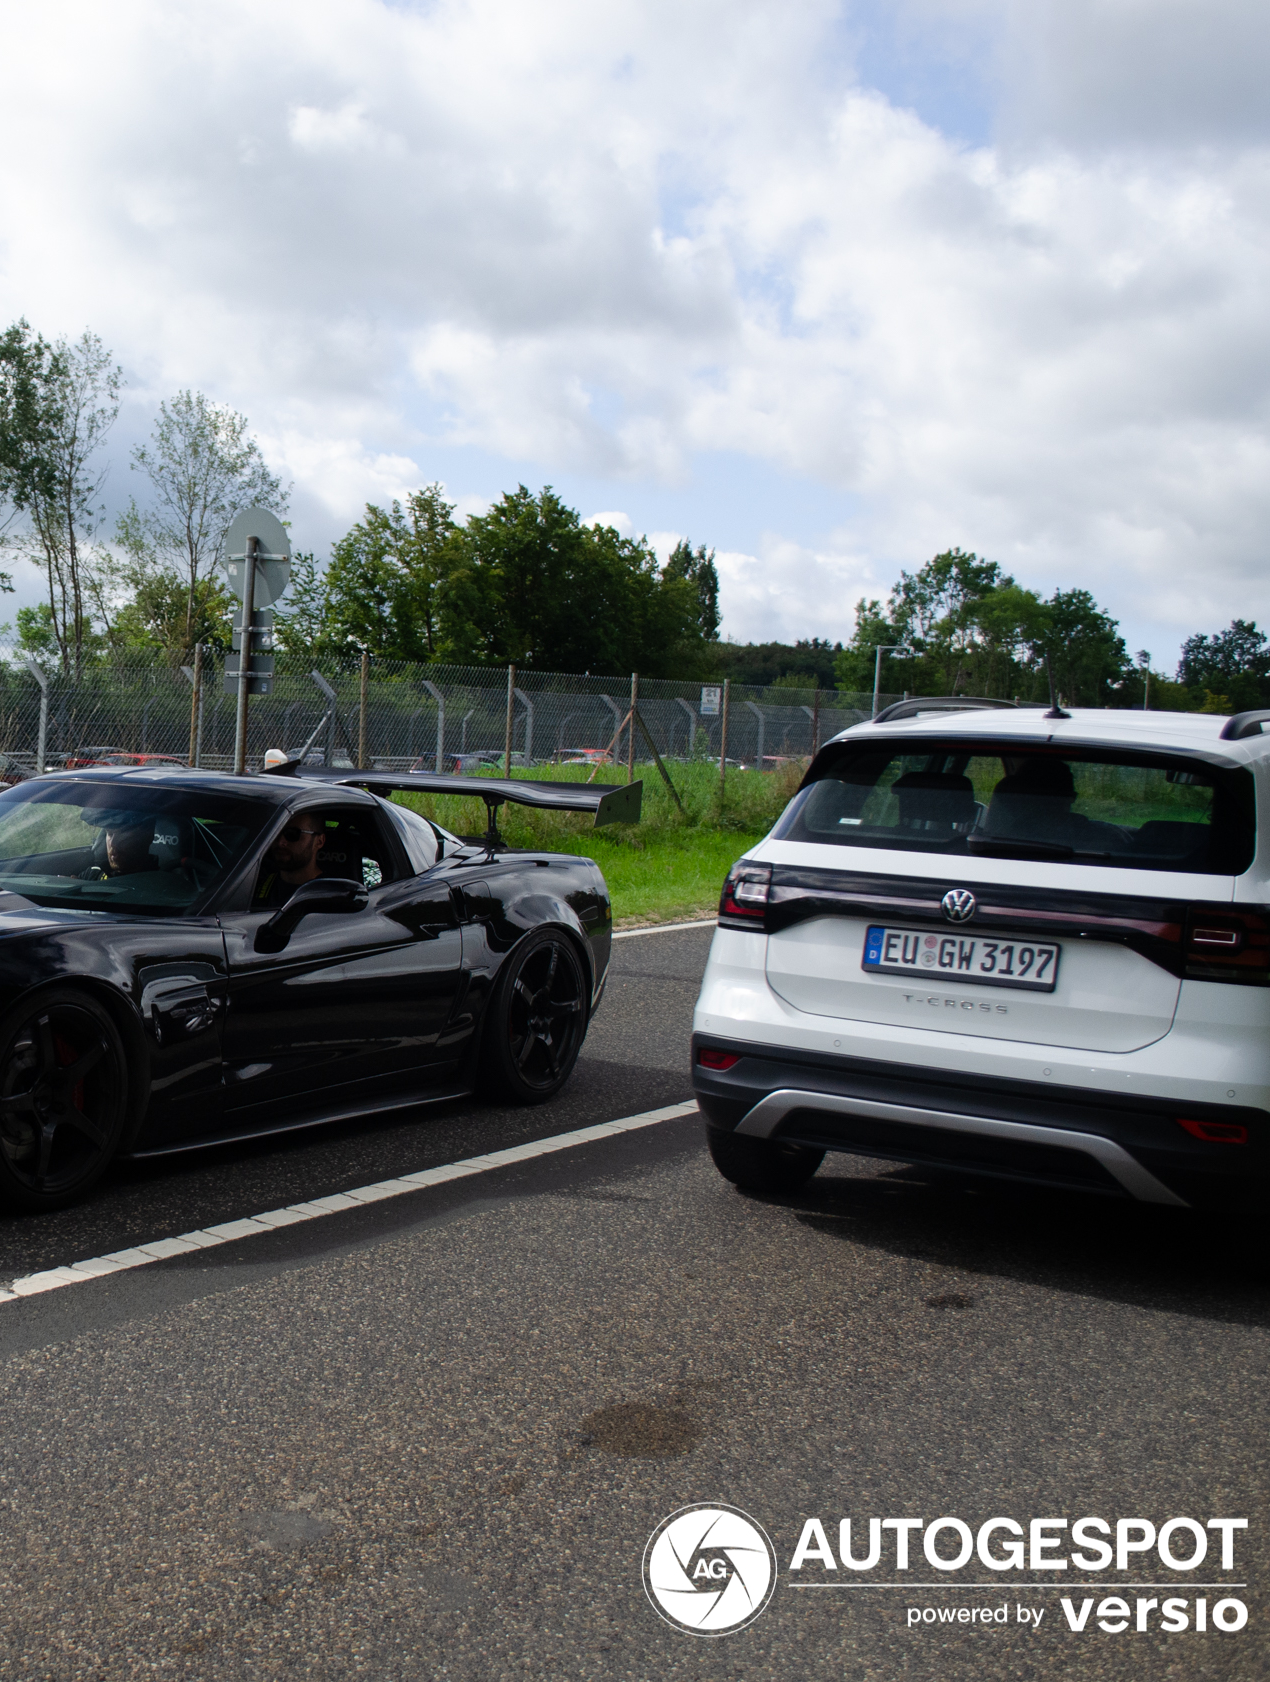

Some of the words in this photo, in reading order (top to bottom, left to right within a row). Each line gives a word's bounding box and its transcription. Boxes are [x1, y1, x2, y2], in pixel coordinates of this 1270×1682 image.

[883, 933, 919, 965] EU
[938, 939, 976, 970] GW
[980, 943, 1054, 979] 3197
[902, 994, 1008, 1015] T-CROSS
